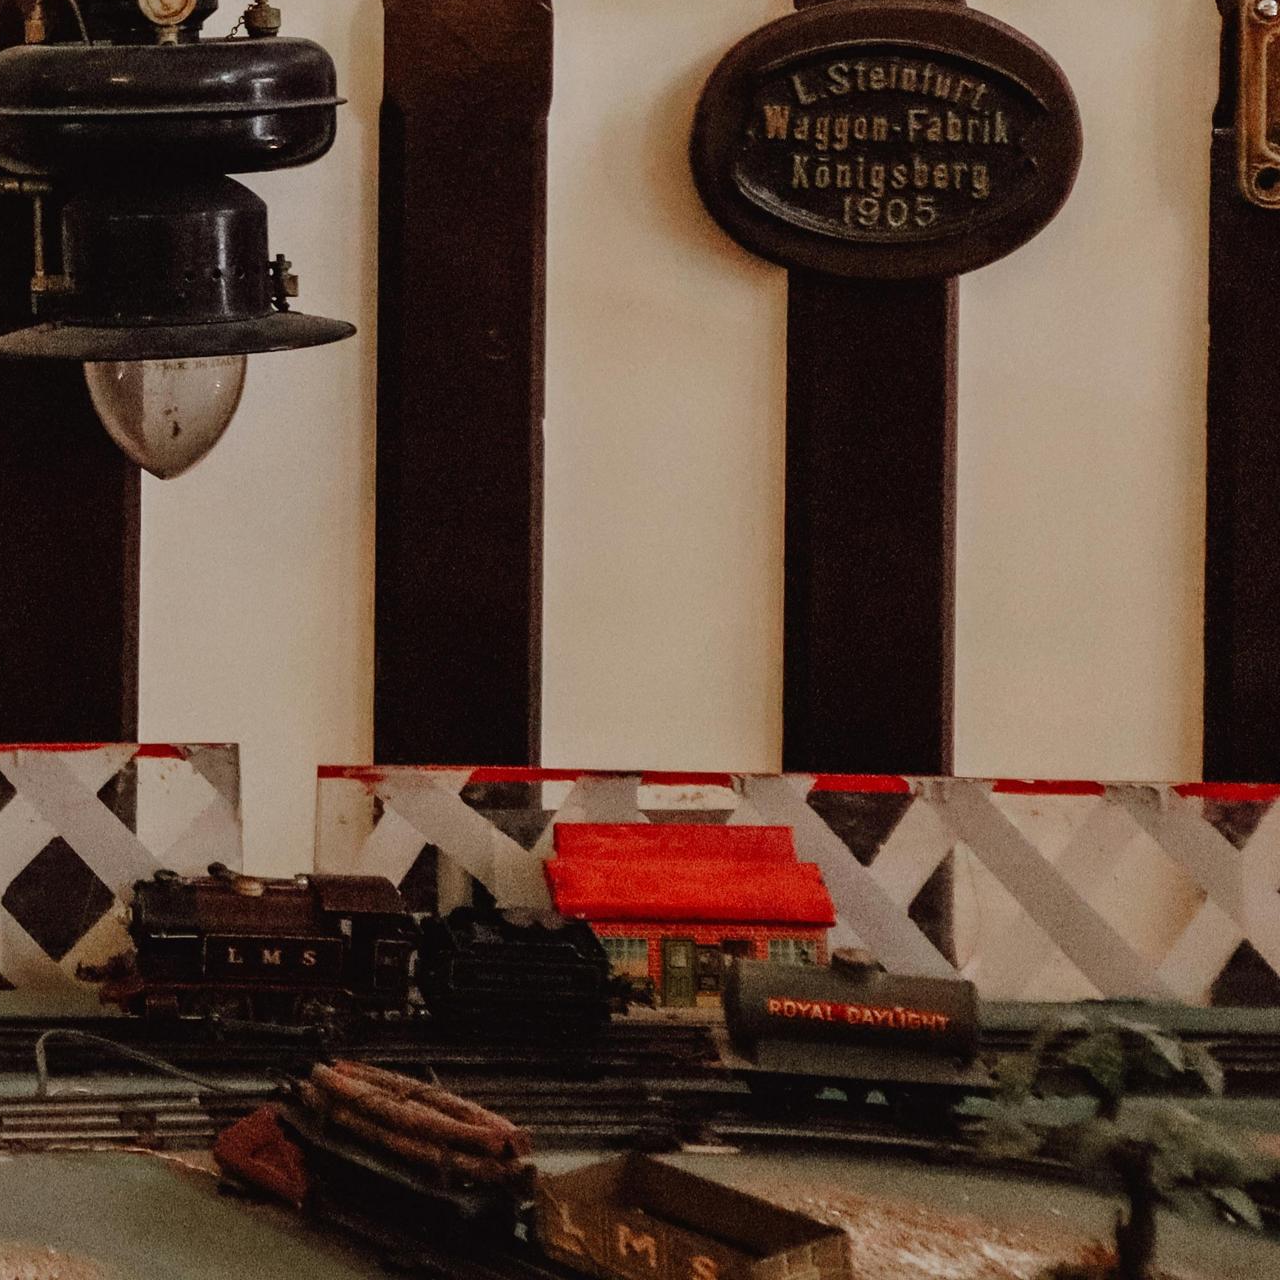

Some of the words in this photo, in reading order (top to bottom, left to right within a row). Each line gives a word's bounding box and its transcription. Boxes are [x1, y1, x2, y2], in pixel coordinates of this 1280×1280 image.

[791, 153, 990, 200] Königsberg
[843, 195, 938, 227] 1905
[767, 998, 835, 1022] ROYAL
[845, 1005, 951, 1032] DAYLIGHT
